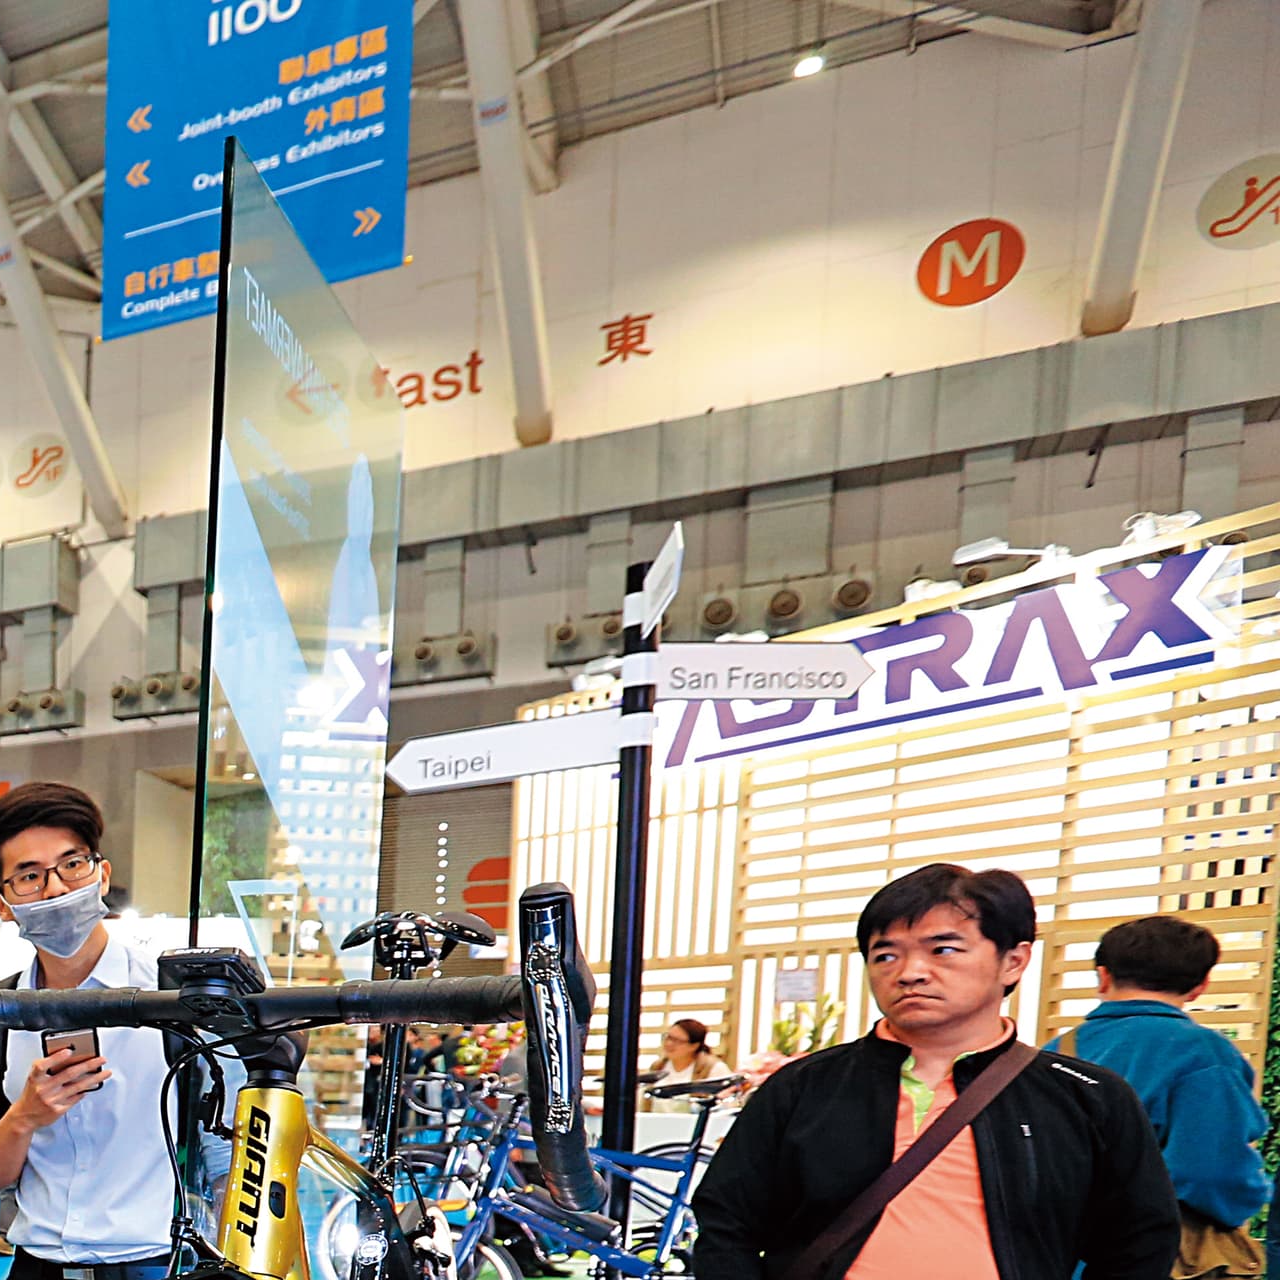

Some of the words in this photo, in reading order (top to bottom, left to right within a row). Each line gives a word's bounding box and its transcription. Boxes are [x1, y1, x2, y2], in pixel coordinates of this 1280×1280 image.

[178, 96, 282, 141] Joint-booth
[288, 62, 387, 104] Exhibitors
[286, 122, 385, 163] Exhibitors
[936, 231, 1002, 297] M
[121, 284, 200, 319] Complete
[597, 313, 654, 367] 東
[396, 349, 484, 408] ast
[669, 666, 719, 691] San
[727, 665, 848, 691] Francisco
[419, 751, 494, 781] Taipei
[236, 1104, 272, 1249] GIANT
